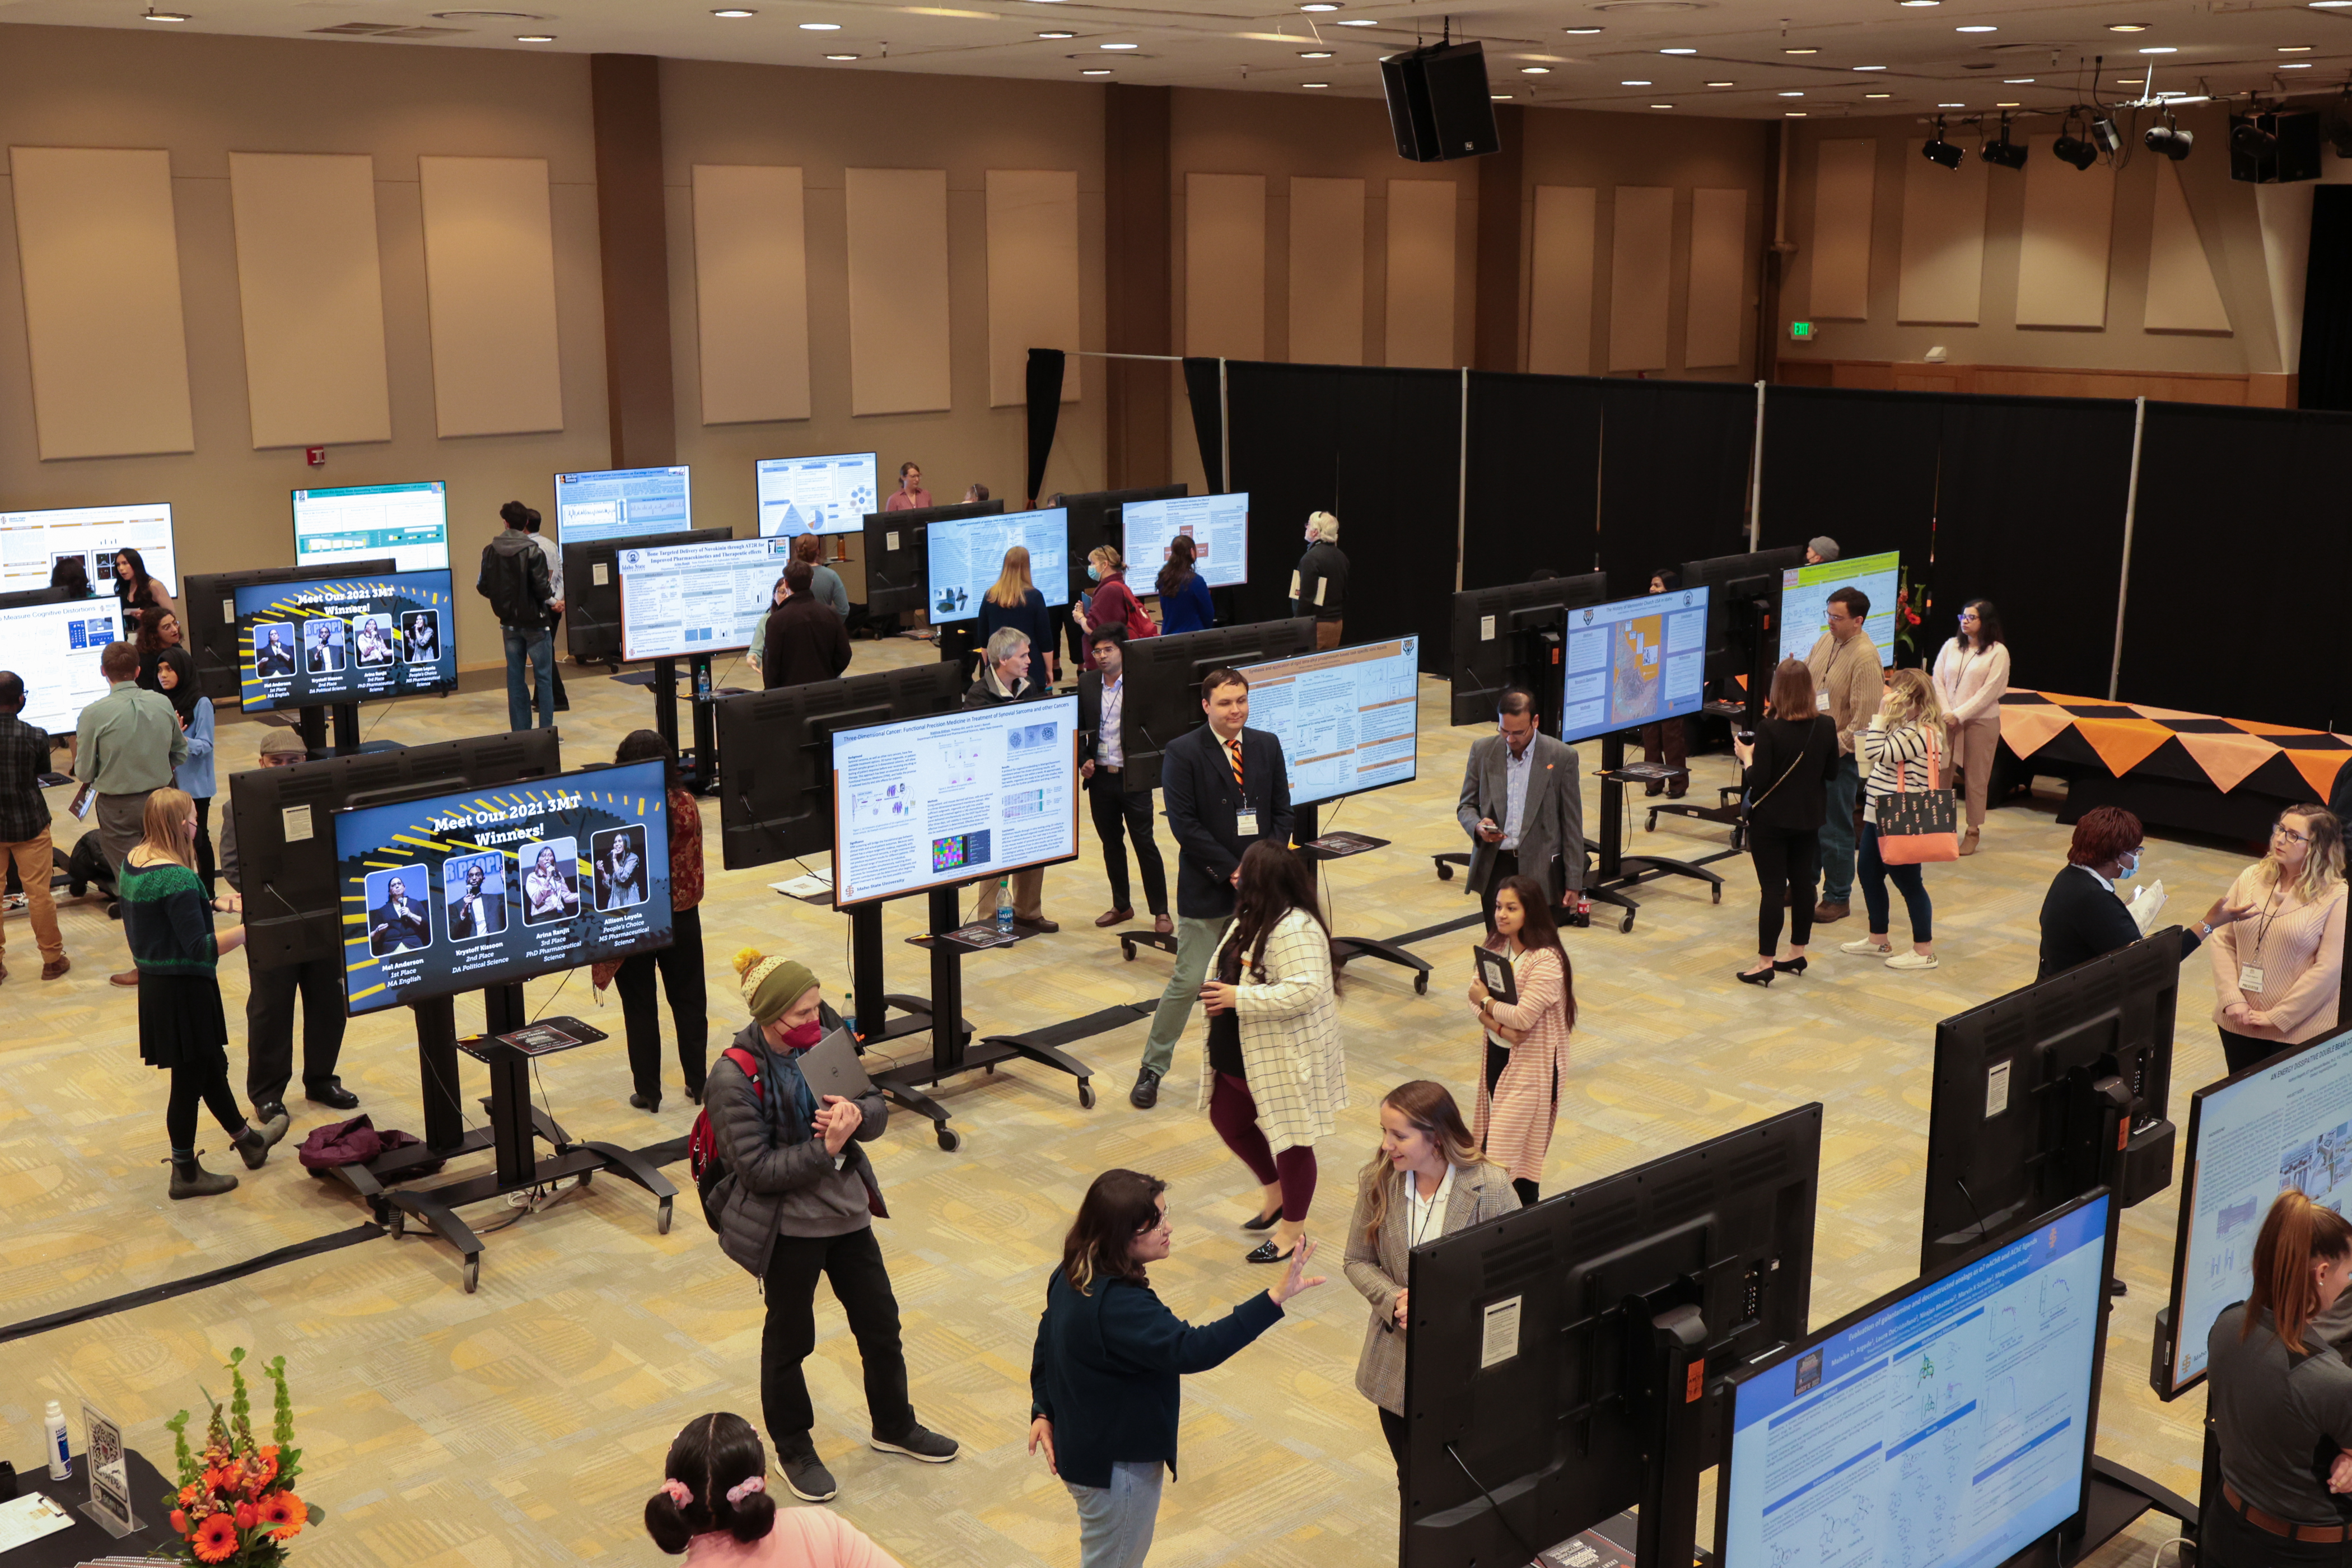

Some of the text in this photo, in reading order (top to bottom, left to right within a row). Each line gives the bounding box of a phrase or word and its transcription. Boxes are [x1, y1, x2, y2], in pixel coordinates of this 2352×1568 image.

[1794, 323, 1809, 335] EXIT
[298, 588, 395, 604] Meet Our 2021 3MT
[32, 610, 61, 618] Cognitive
[324, 604, 370, 615] Winners!
[843, 730, 885, 741] Three-Dimensional
[903, 724, 925, 732] Functional
[434, 796, 581, 832] Meet Our 2021 3MT
[475, 824, 544, 846] Winners!
[552, 927, 570, 935] Ranjit
[603, 923, 625, 932] People's
[608, 926, 649, 939] Pharmaceutical
[456, 945, 479, 955] Krystoff
[539, 941, 581, 954] Pharmaceutical
[394, 959, 423, 968] Anderson
[463, 960, 486, 970] Political
[399, 974, 421, 984] English
[2270, 1072, 2276, 1080] AN
[2277, 1065, 2293, 1077] ENERGY
[2294, 1053, 2318, 1070] DISSIPATIVE
[2319, 1047, 2335, 1058] DOUBLE
[2335, 1042, 2346, 1051] BEAM
[1849, 1323, 1874, 1340] Evaluation
[1875, 1318, 1880, 1327] of
[1881, 1304, 1911, 1325] galantamine
[1911, 1297, 1921, 1308] and
[1921, 1280, 1954, 1302] deconstructed
[1954, 1272, 1972, 1285] analogs
[2001, 1252, 2010, 1261] and
[2022, 1239, 2037, 1250] ligands
[2194, 1351, 2207, 1362] Idaho
